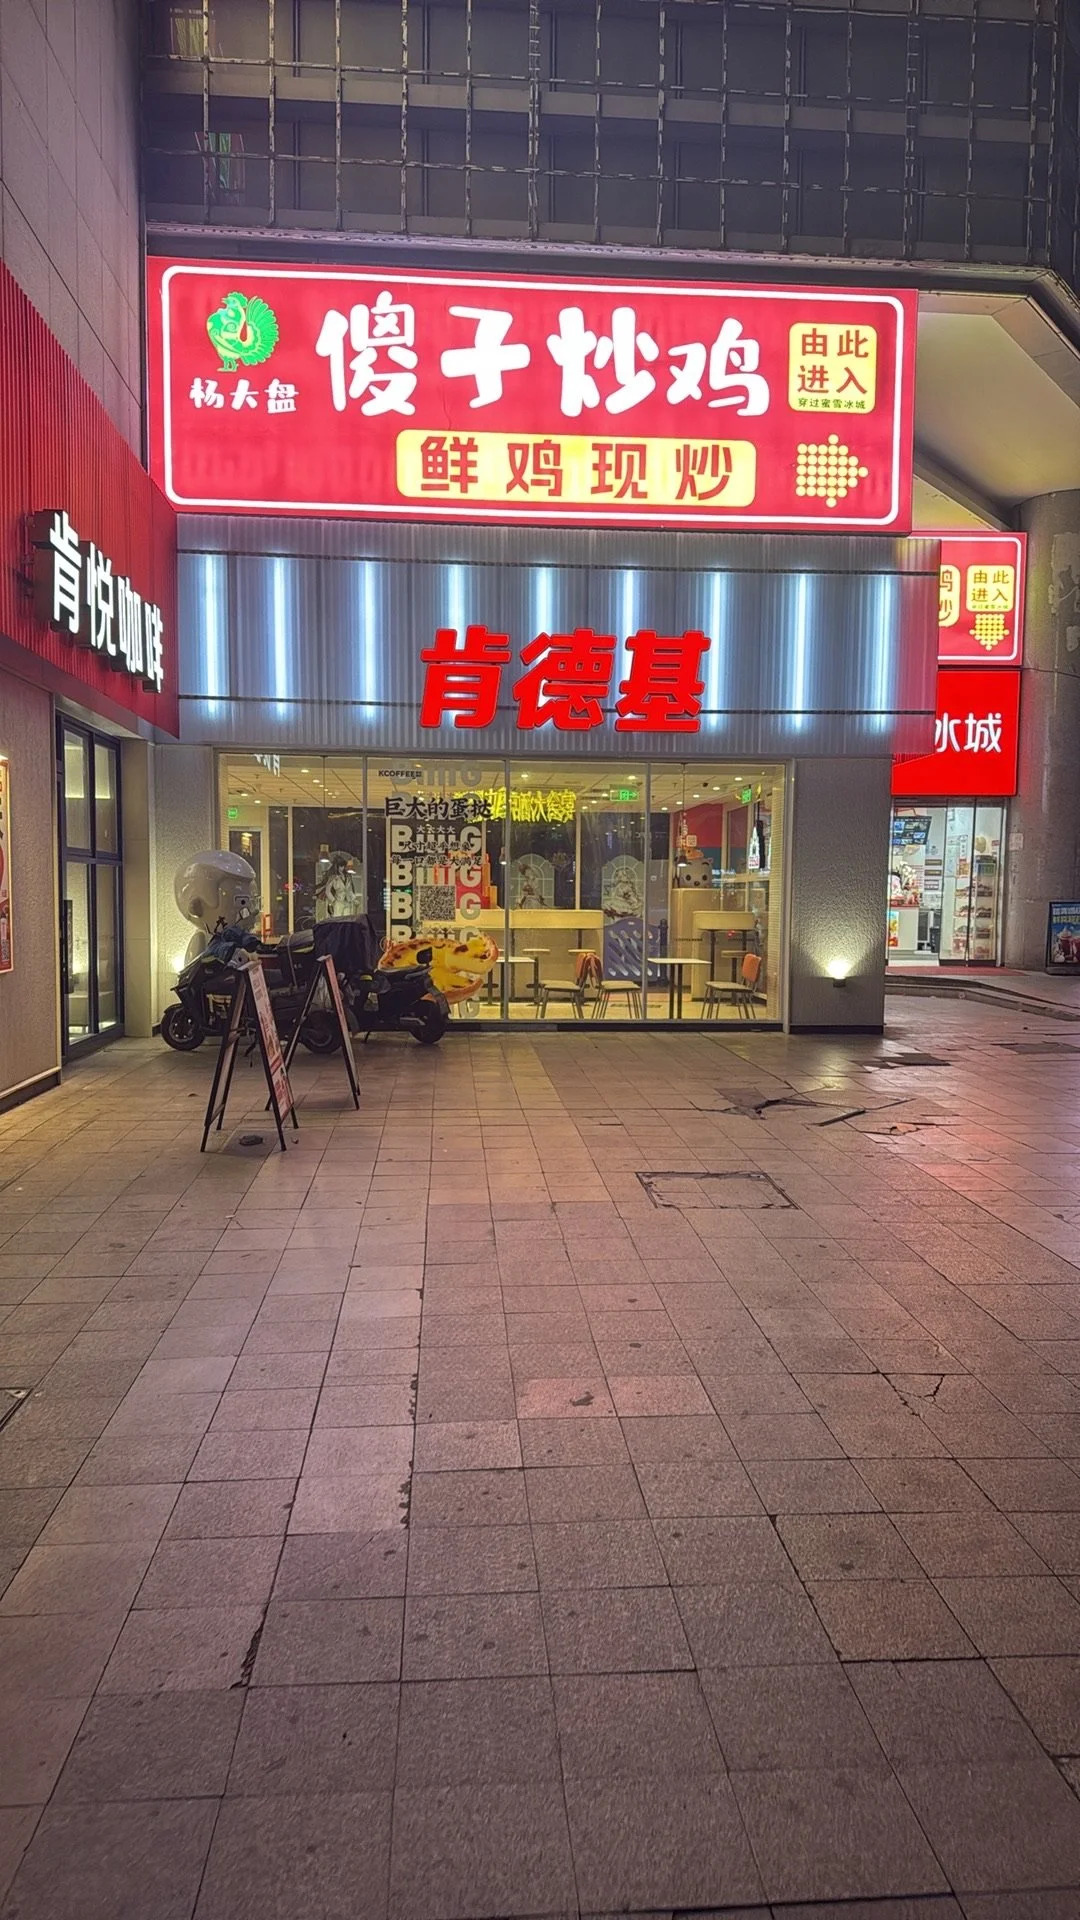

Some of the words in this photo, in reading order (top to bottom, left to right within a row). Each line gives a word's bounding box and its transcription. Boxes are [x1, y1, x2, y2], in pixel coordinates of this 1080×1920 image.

[316, 291, 769, 416] 傻子炒鸡
[801, 328, 869, 358] 由此
[797, 365, 868, 394] 进入
[189, 377, 299, 414] 杨大盘
[798, 397, 866, 410] 穿过蜜雪冰城
[420, 436, 733, 501] 鲜鸡现炒
[973, 570, 1010, 584] 由此
[50, 510, 164, 694] 肯悦咖啡
[971, 588, 1009, 602] 进入
[420, 625, 711, 732] 肯德基
[378, 770, 415, 778] KCOFFEE
[385, 796, 493, 818] 巨大的蛋挞
